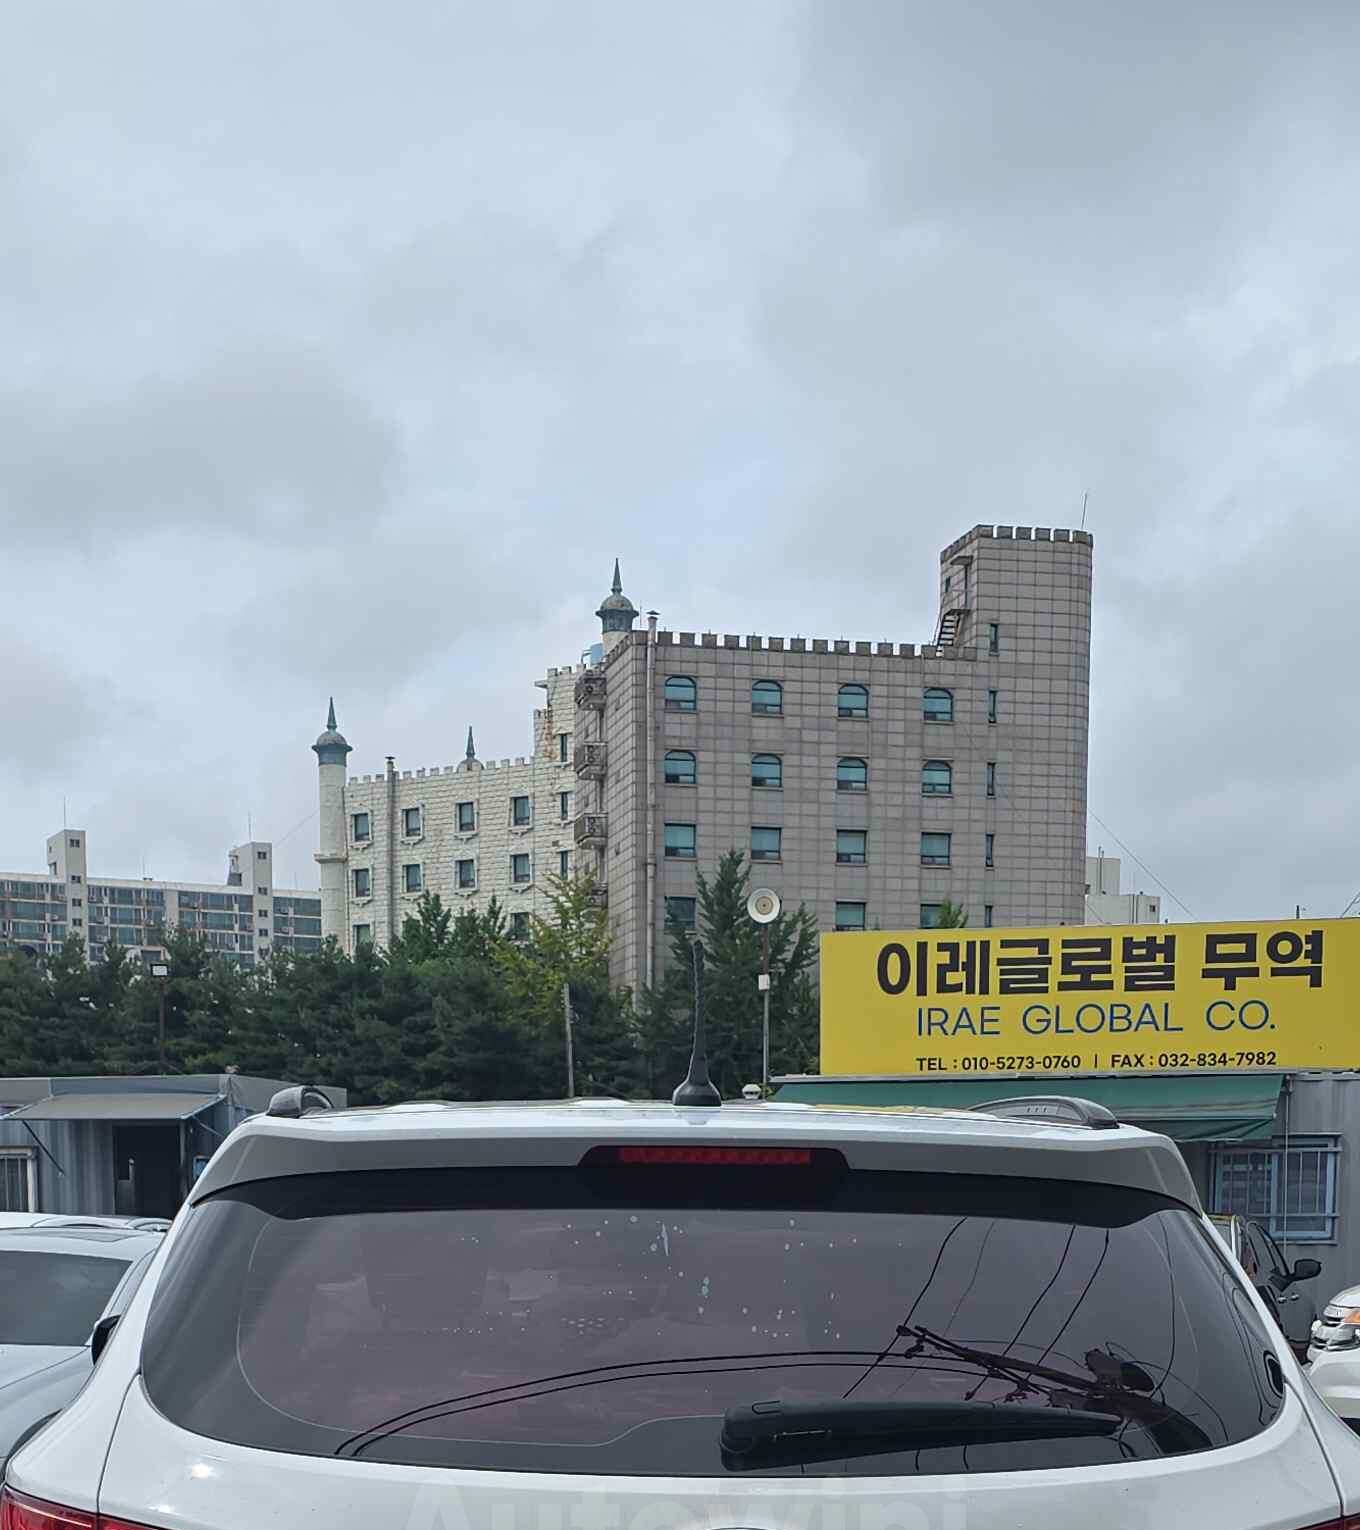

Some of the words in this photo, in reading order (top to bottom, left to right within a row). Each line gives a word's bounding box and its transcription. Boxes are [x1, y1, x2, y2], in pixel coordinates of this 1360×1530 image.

[877, 934, 1176, 997] 이레글로벌
[1201, 930, 1323, 991] 무역
[917, 1006, 1001, 1037] IRAE
[1022, 1002, 1184, 1035] GLOBAL
[1206, 1000, 1276, 1032] CO.
